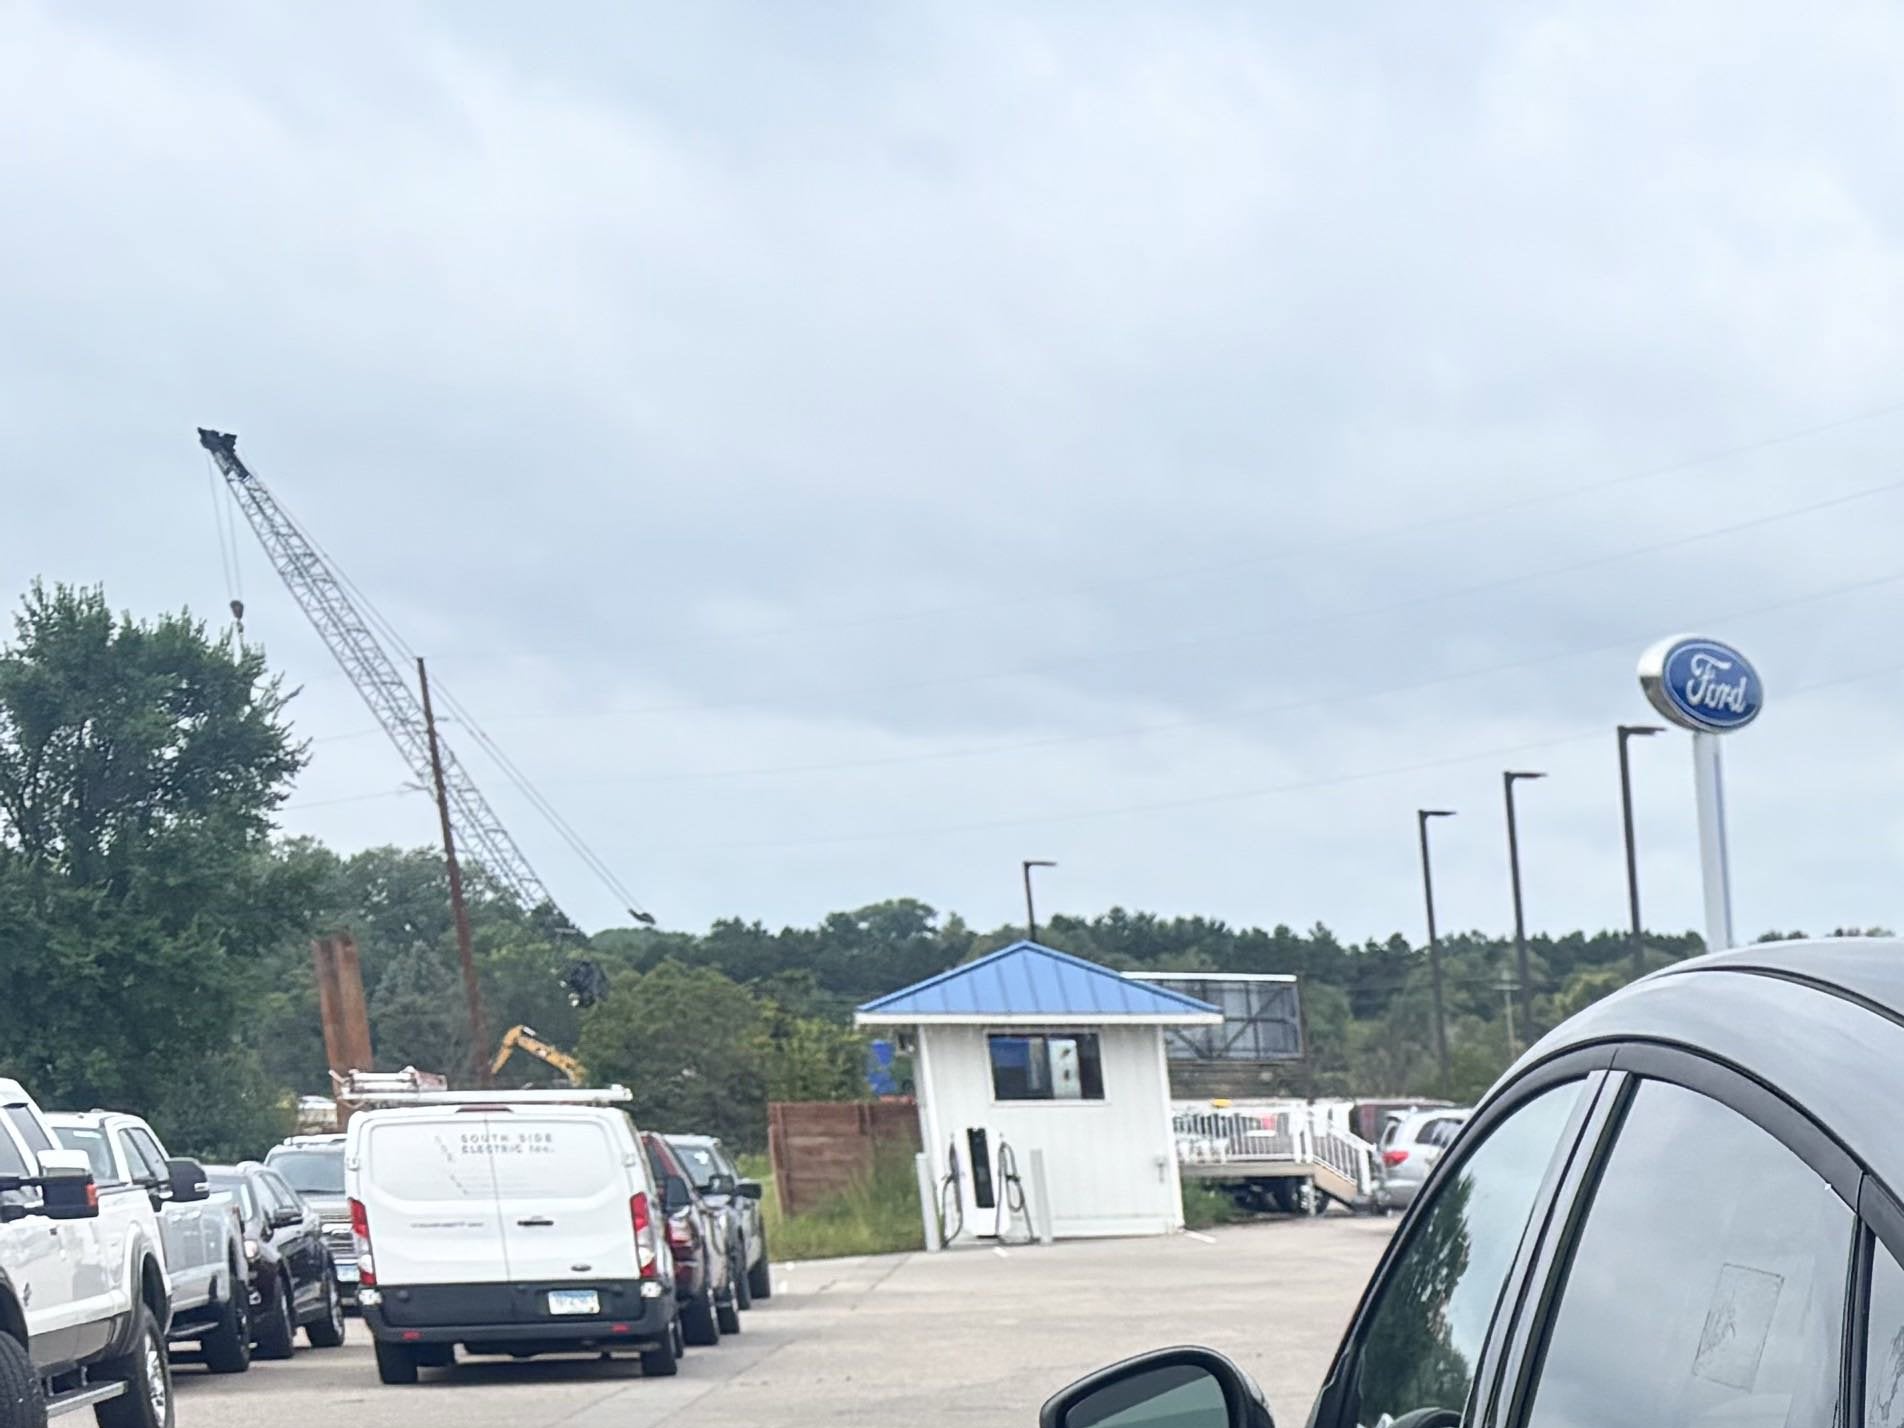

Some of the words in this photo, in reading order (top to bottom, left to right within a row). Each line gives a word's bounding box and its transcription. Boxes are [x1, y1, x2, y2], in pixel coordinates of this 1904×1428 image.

[1686, 653, 1747, 713] Ford
[461, 1133, 509, 1144] SOUTH
[519, 1133, 553, 1143] SIDE
[461, 1144, 523, 1154] ELECTRIC
